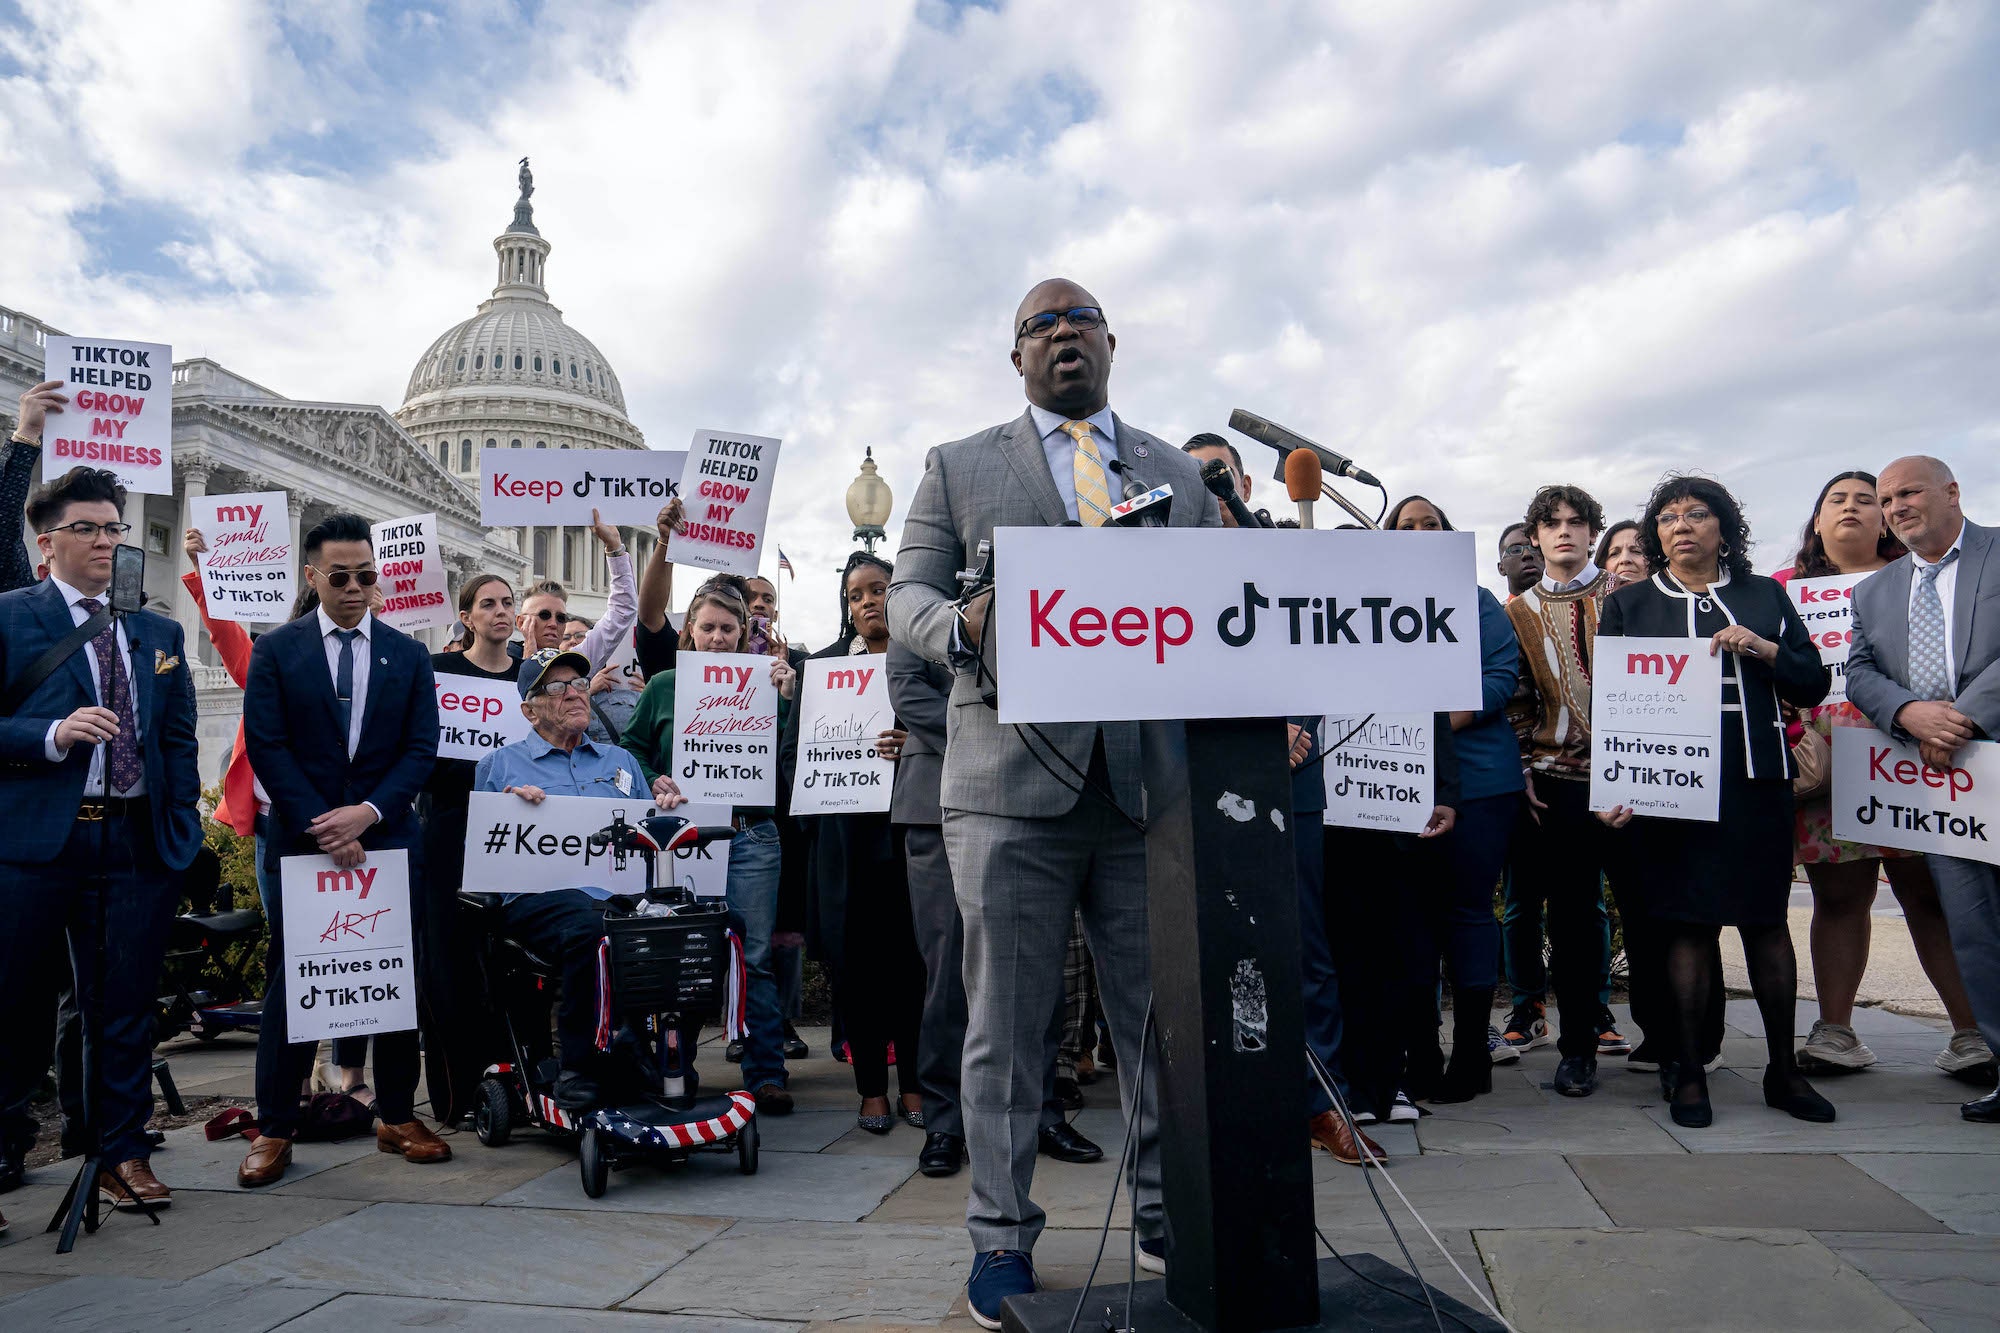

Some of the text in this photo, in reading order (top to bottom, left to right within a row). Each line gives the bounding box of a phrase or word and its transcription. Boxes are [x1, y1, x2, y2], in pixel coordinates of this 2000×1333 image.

[72, 346, 150, 368] TIKTOK
[71, 367, 152, 391] HELPED
[77, 390, 145, 416] GROW
[92, 418, 128, 438] MY
[56, 439, 162, 466] BUSINESS
[709, 439, 762, 461] TIKTOK
[700, 459, 758, 482] HELPED
[494, 473, 678, 504] Keep TikTok
[700, 480, 750, 504] GROW
[708, 504, 735, 522] MY
[1114, 489, 1169, 514] VOA
[217, 505, 263, 528] my
[214, 522, 268, 548] small
[382, 523, 423, 542] TIKTOK
[207, 544, 290, 568] business
[380, 541, 425, 559] HELPED
[208, 570, 286, 581] thrives on
[382, 560, 423, 577] GROW
[229, 590, 285, 602] TikTok
[395, 579, 416, 593] MY
[1029, 589, 1459, 664] Keep TikTok
[704, 666, 753, 692] my
[1627, 653, 1690, 685] my
[827, 668, 874, 695] my
[434, 684, 502, 722] eep
[696, 687, 756, 711] small
[1606, 691, 1687, 702] education
[1608, 706, 1678, 719] platform
[684, 713, 776, 736] business
[814, 711, 880, 745] Family
[1332, 719, 1425, 750] TEACHING
[684, 738, 768, 754] thrives on
[807, 747, 862, 762] thrives
[1604, 736, 1710, 758] thrives on
[703, 764, 763, 780] TikTok
[1335, 752, 1425, 775] thrives on
[1869, 746, 1974, 802] Keep
[824, 771, 881, 787] TikTok
[1628, 766, 1704, 788] TikTok
[1357, 782, 1421, 804] TikTok
[1629, 799, 1679, 809] #KeepTikTok
[1357, 813, 1400, 823] #KeepTikTok
[1888, 804, 1988, 842] TikTok
[317, 867, 378, 899] my
[320, 908, 391, 943] ART
[298, 957, 403, 978] thrives on
[325, 984, 401, 1007] TikTok
[328, 1018, 379, 1029] #KeepTikTok
